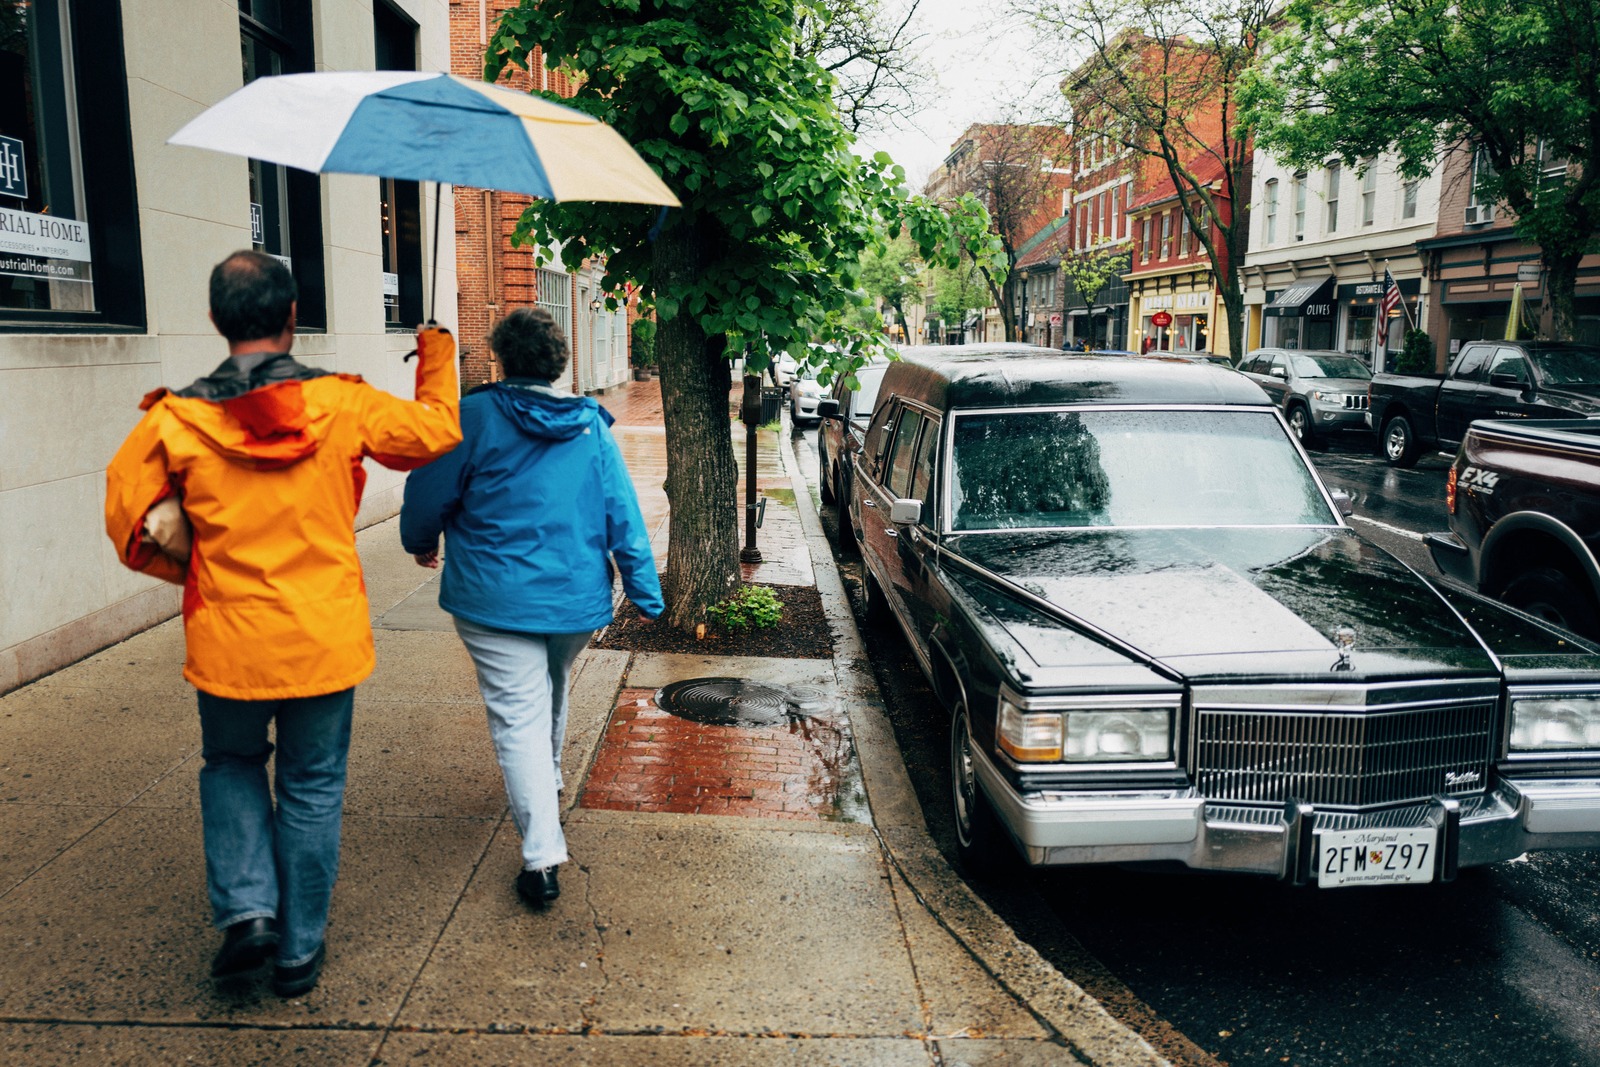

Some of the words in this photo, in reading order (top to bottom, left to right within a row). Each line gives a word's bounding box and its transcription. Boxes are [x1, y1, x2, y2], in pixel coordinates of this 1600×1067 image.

[1306, 304, 1330, 316] OLIVES
[1460, 466, 1500, 489] FX4
[1354, 833, 1398, 846] Maryland
